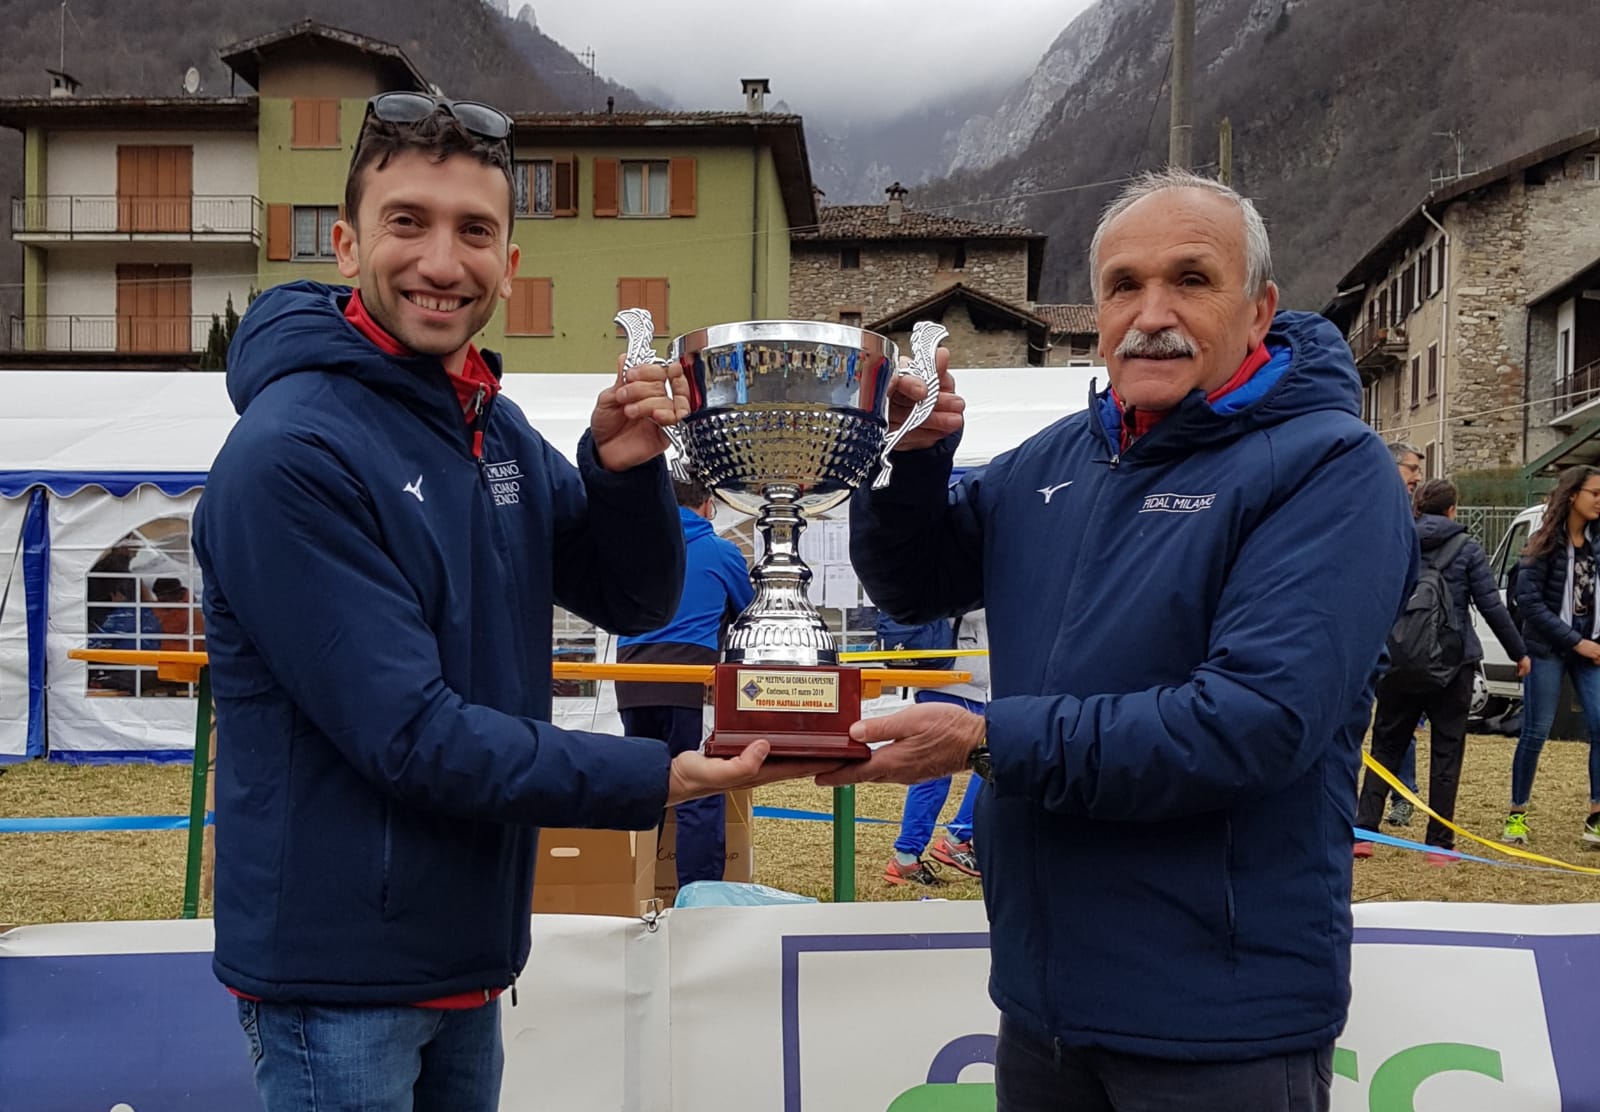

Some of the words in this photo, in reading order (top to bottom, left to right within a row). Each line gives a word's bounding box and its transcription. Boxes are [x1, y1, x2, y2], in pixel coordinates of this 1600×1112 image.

[488, 464, 519, 478] MILANO
[1142, 497, 1170, 509] FIDAL
[1172, 496, 1215, 509] MILANO
[765, 676, 785, 685] MEETING
[786, 677, 791, 685] DI
[792, 677, 807, 685] CORSA
[808, 677, 834, 685] CAMPESTRE
[812, 688, 824, 696] 2019
[756, 699, 775, 707] TROFEO
[776, 699, 800, 707] MASTALLI
[802, 700, 822, 708] ANDREA
